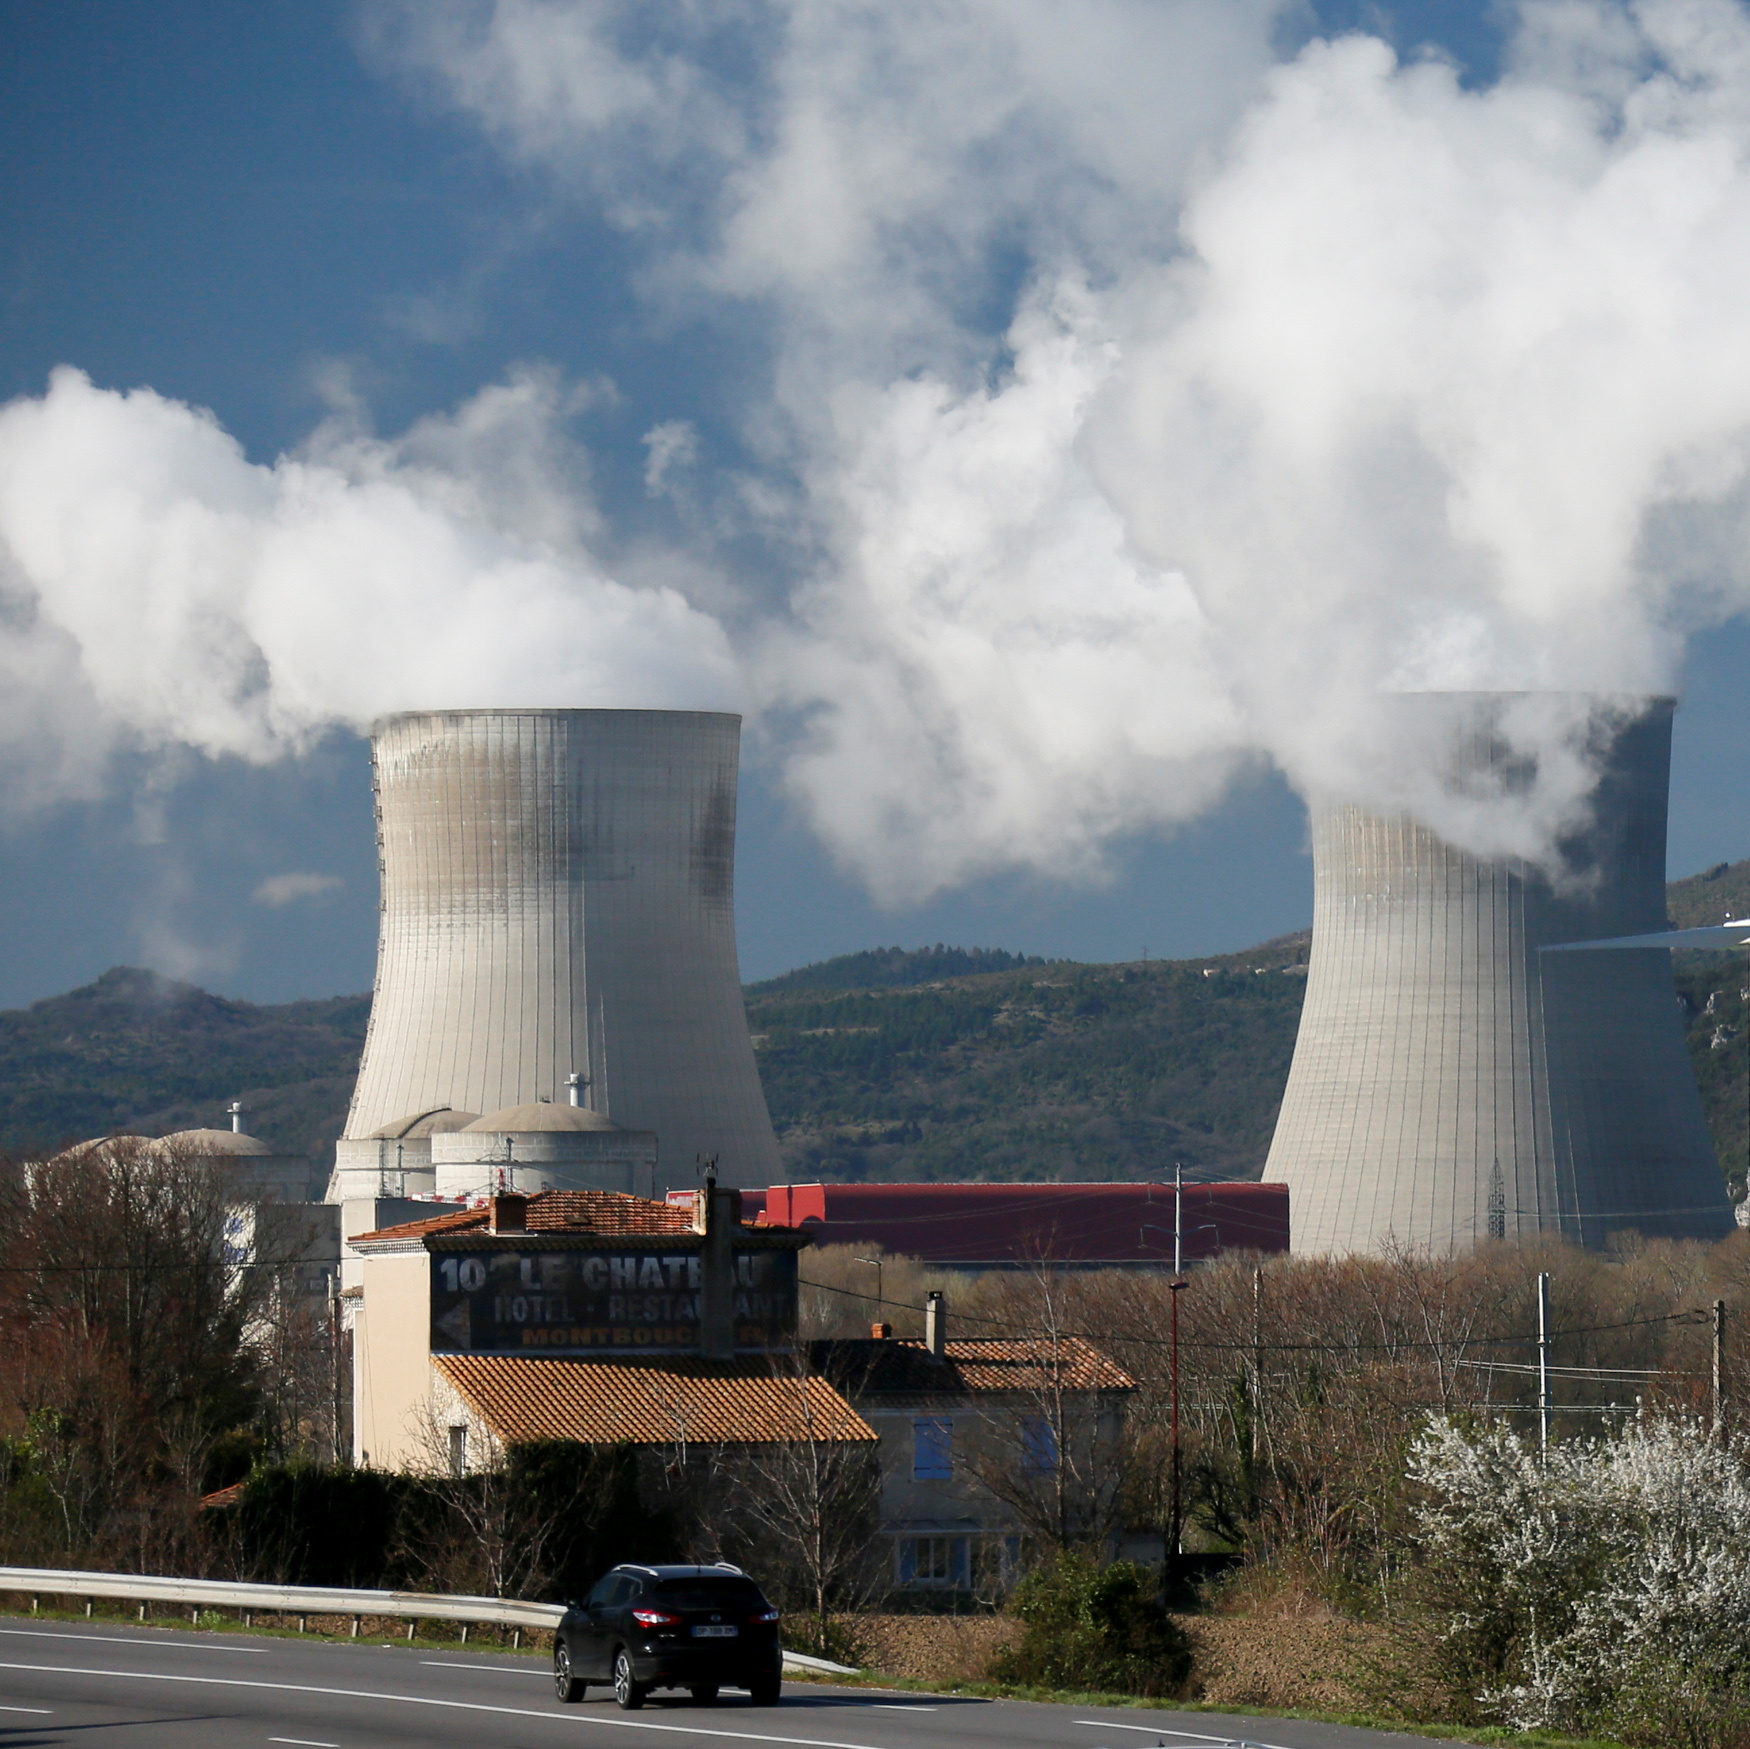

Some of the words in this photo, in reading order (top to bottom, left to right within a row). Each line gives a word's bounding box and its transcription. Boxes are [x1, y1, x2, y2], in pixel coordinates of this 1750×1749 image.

[520, 1256, 566, 1291] LE
[582, 1255, 764, 1291] CHATEU
[494, 1294, 575, 1323] HOTEL
[521, 1326, 765, 1346] MONTBOUCR
